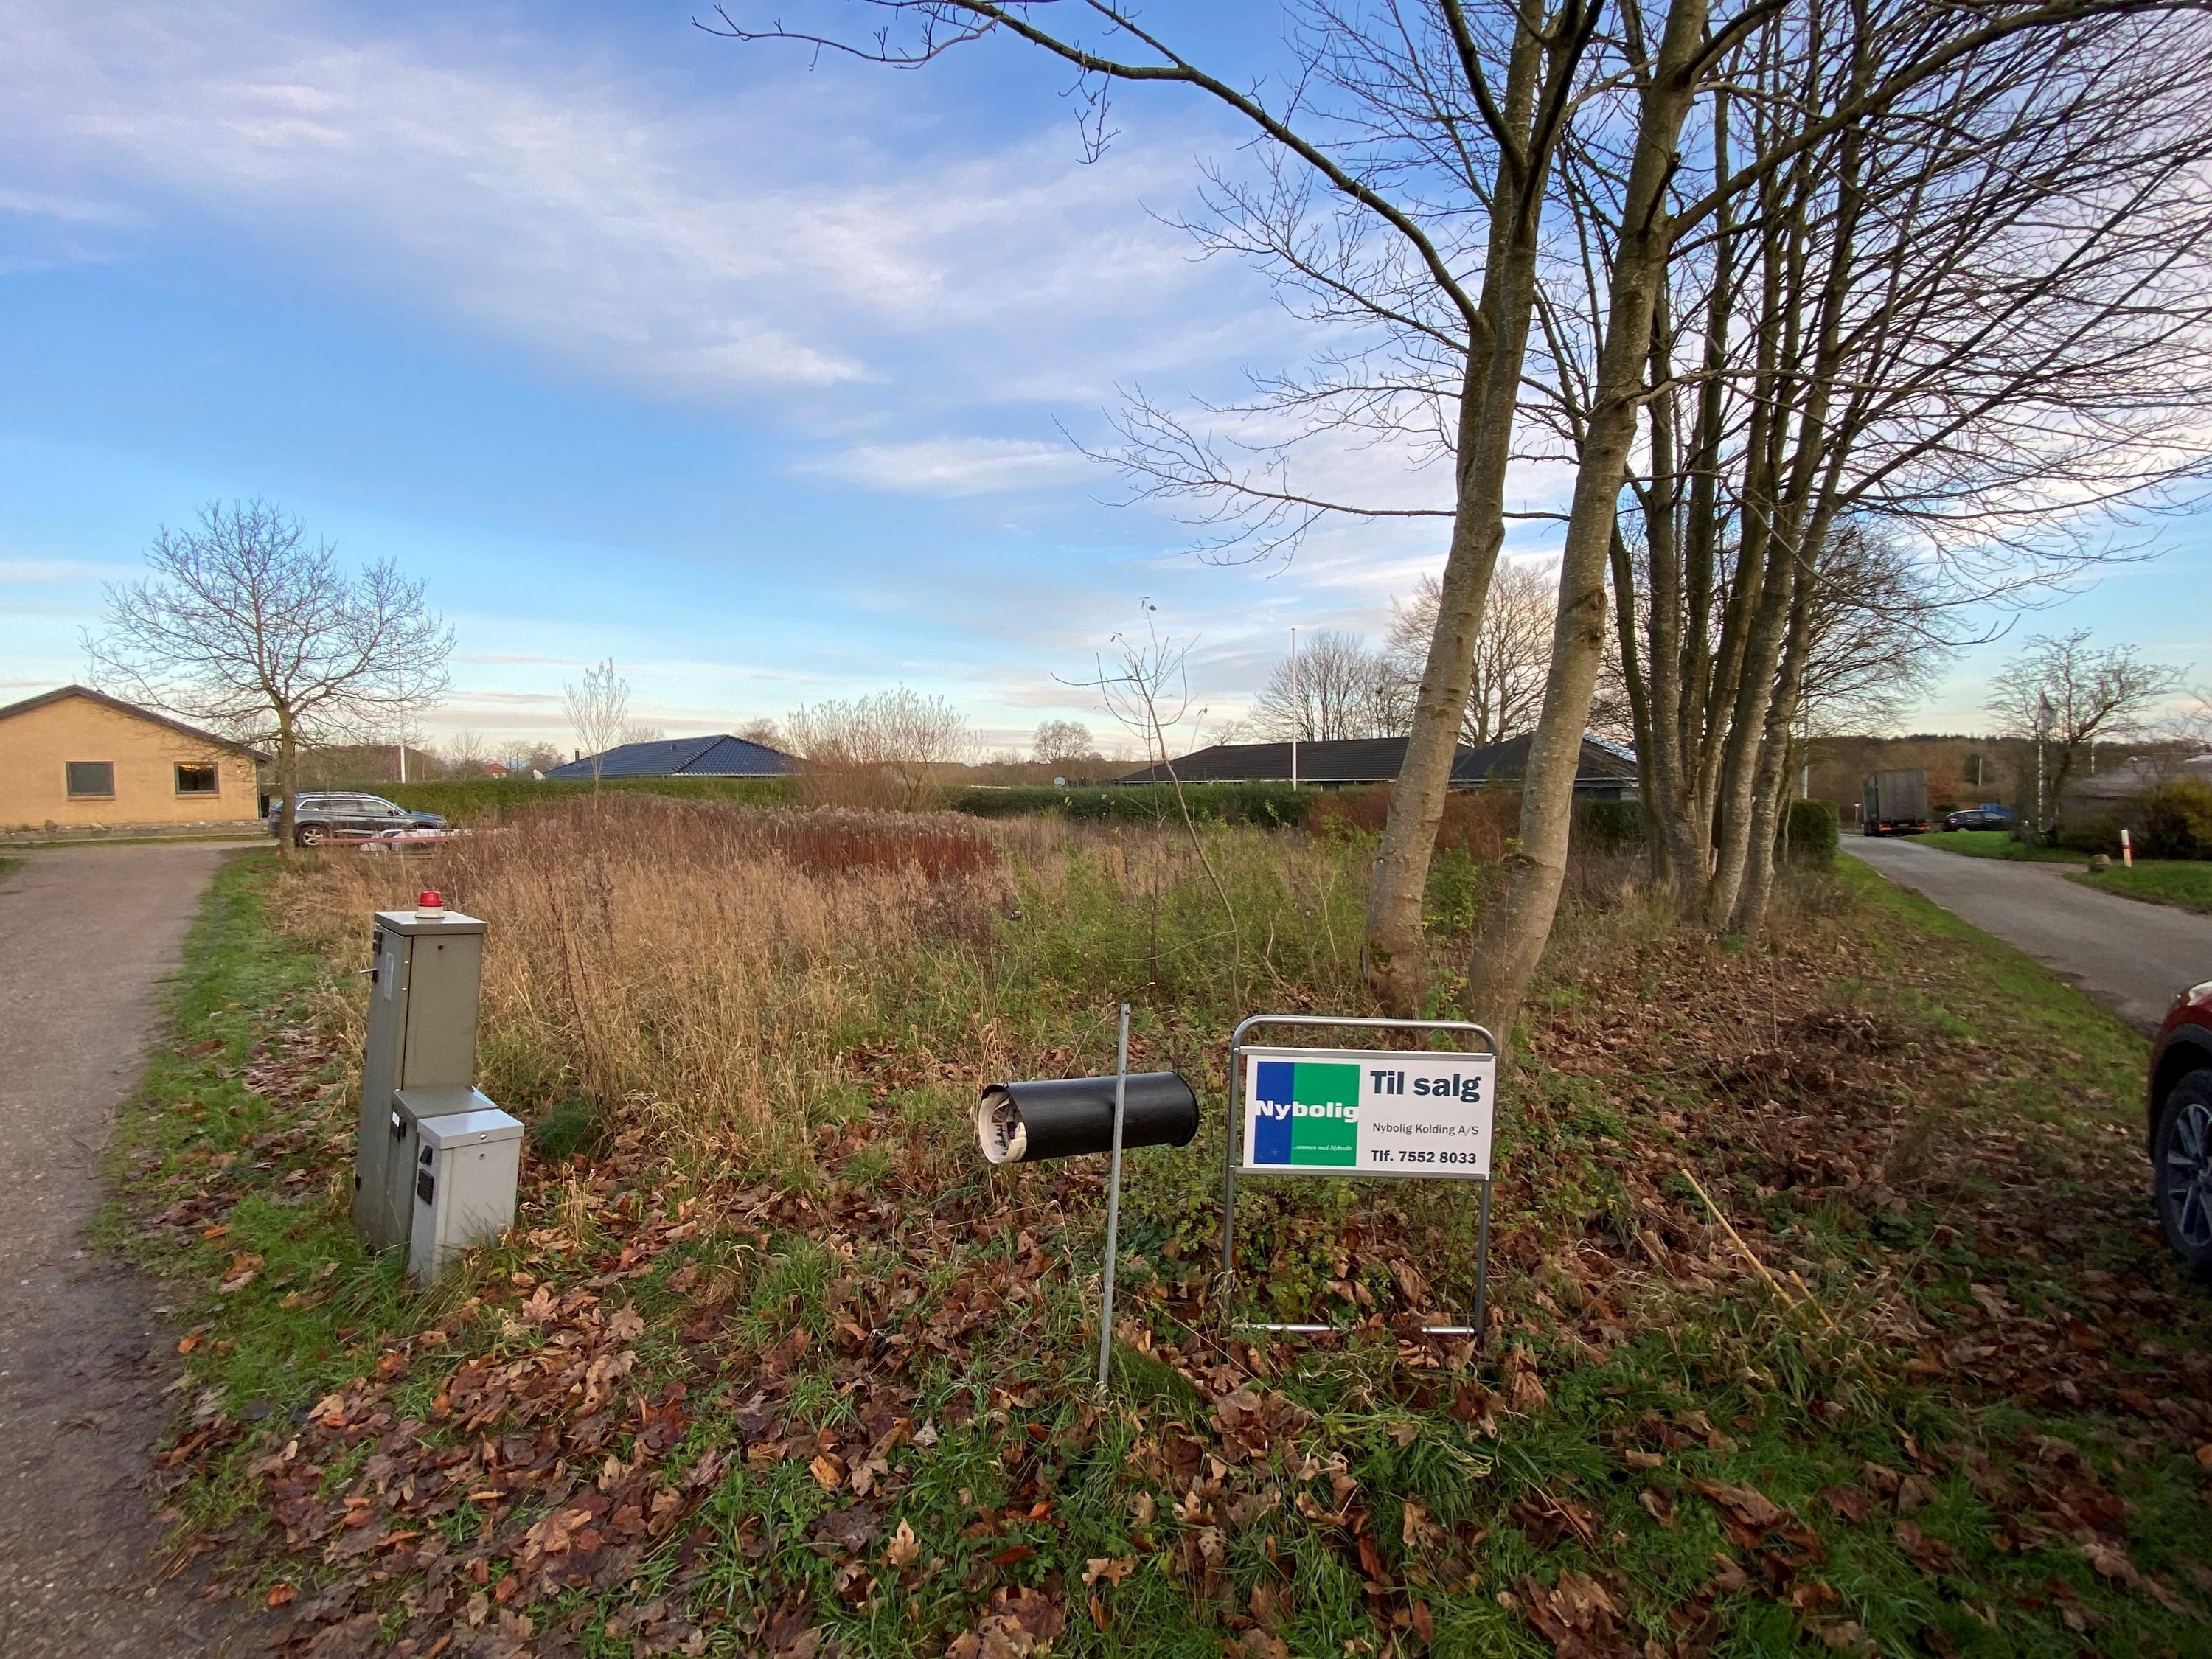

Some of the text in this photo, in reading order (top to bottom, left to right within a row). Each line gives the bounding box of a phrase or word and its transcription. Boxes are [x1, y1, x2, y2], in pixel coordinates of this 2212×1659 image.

[1370, 1070, 1481, 1103] Til salg
[1255, 1099, 1359, 1123] Nybolig
[1372, 1122, 1479, 1137] Nybolig Kolding A/S
[1371, 1150, 1477, 1164] Tlf. 7552 8033
